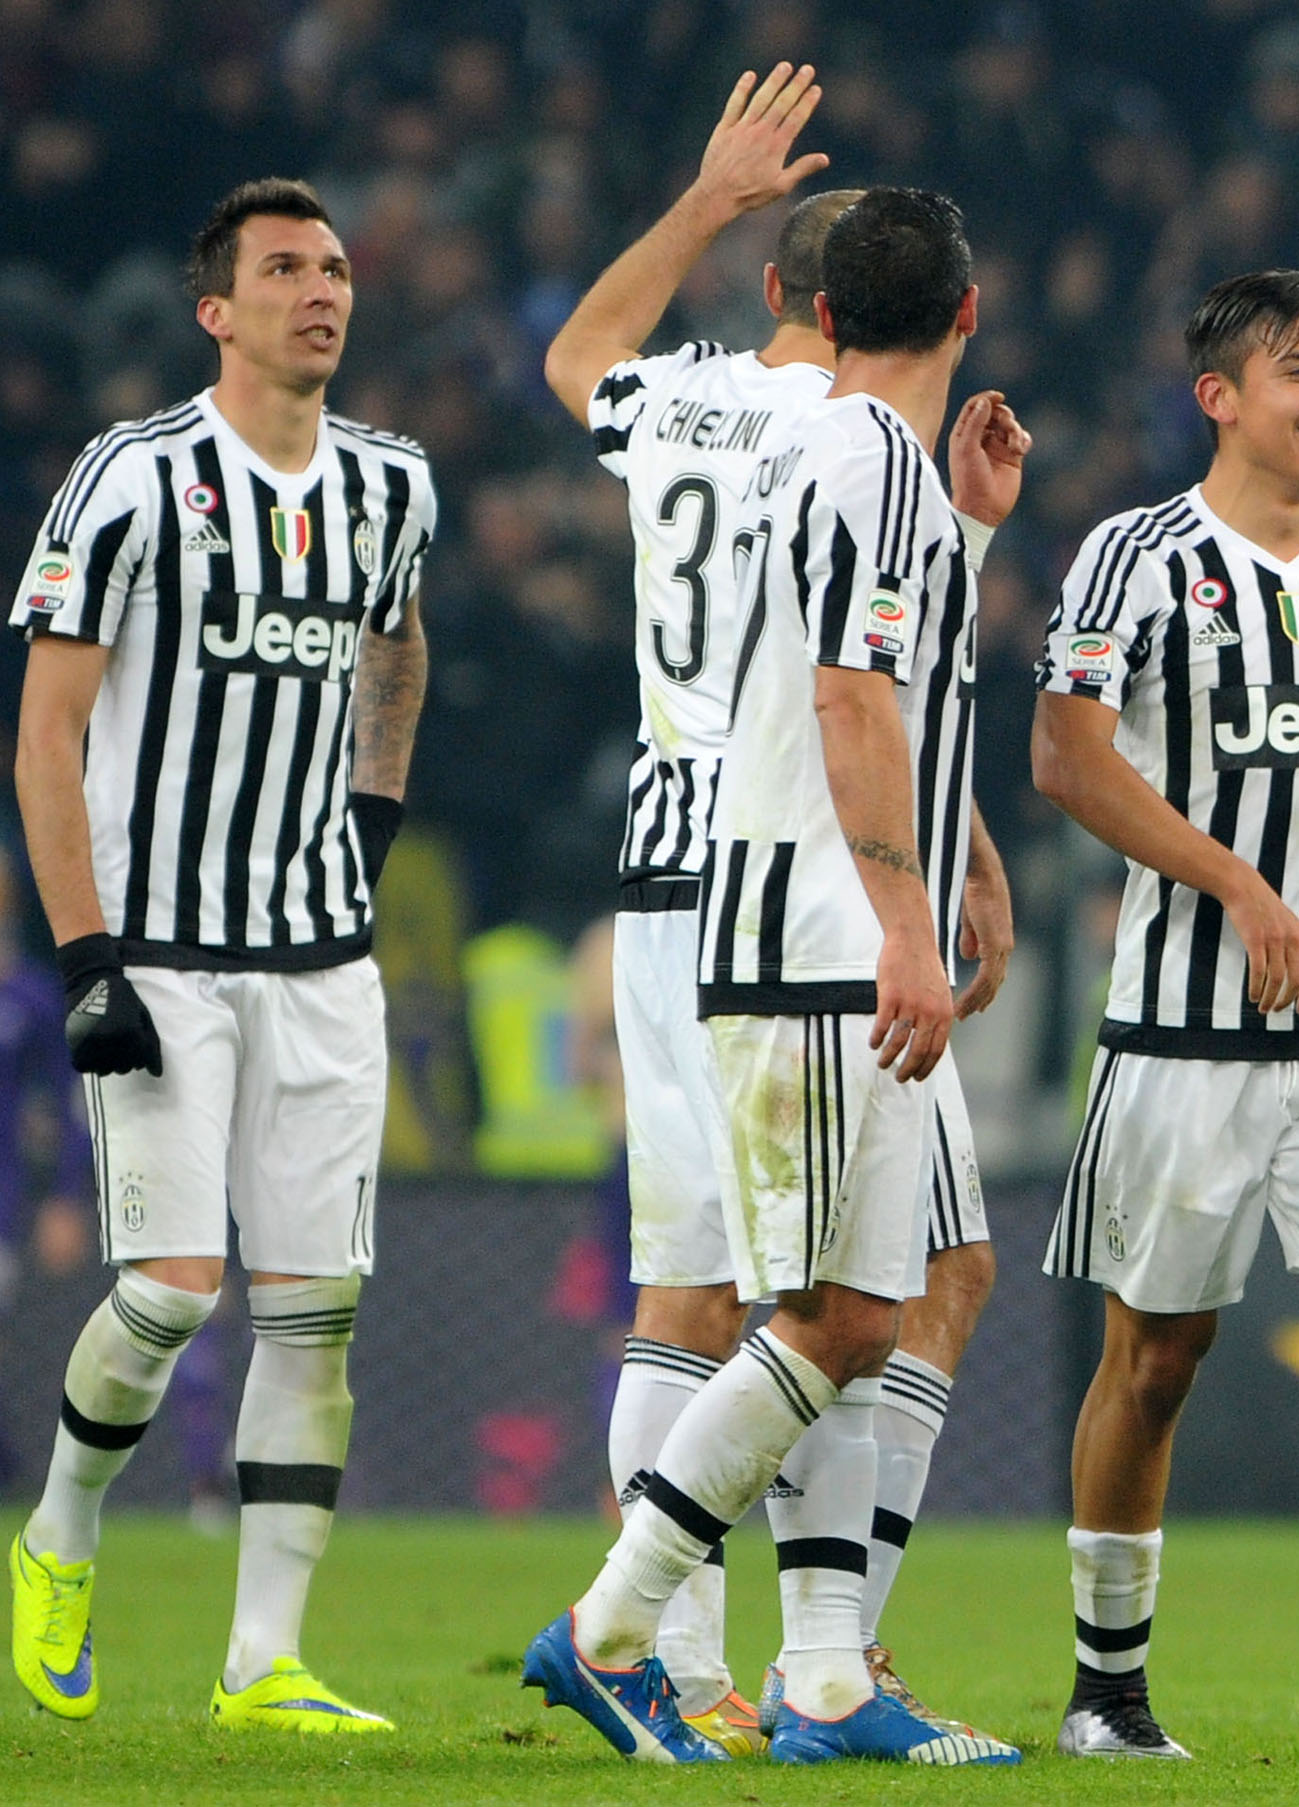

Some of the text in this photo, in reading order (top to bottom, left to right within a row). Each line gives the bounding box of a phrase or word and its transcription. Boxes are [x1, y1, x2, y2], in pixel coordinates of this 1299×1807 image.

[656, 398, 773, 453] CHIEINI
[650, 472, 720, 686] 3
[203, 594, 356, 682] Jeep
[1193, 632, 1239, 646] adidas
